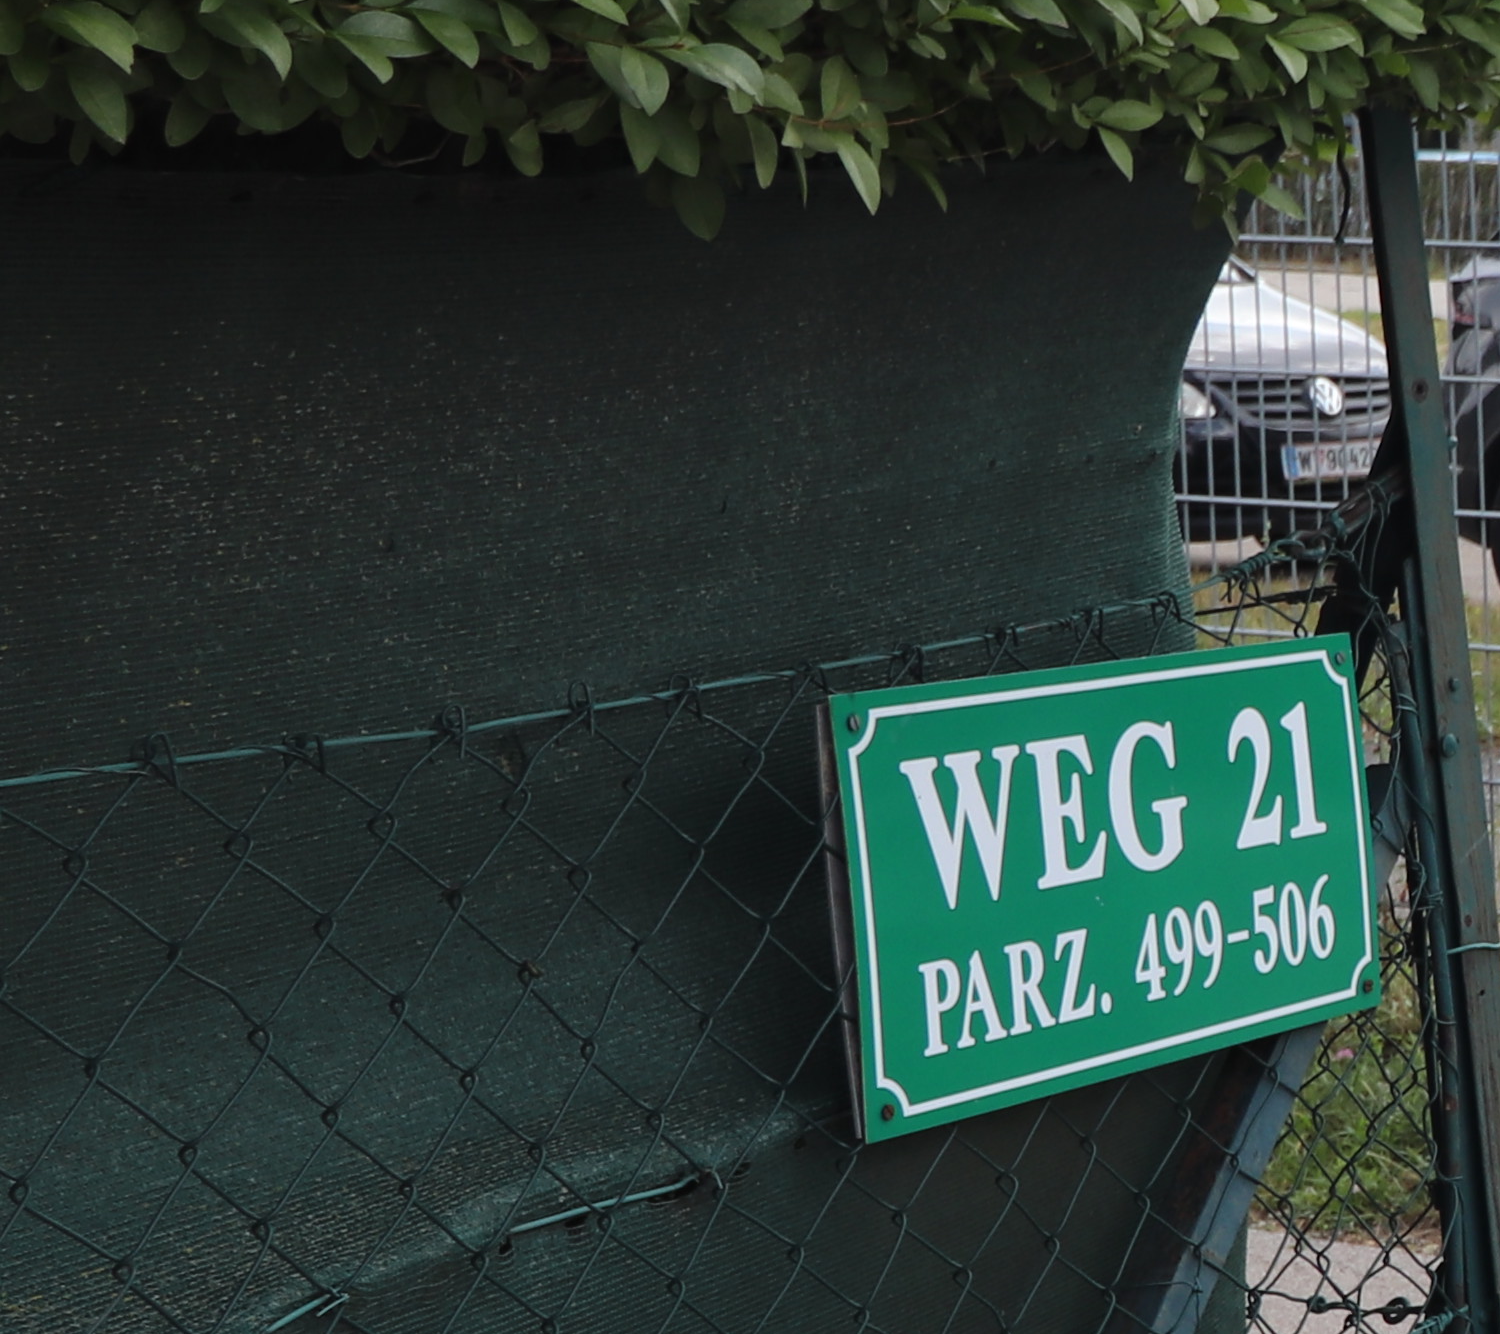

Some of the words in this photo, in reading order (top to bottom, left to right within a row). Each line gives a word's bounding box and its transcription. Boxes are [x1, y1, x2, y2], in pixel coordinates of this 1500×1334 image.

[899, 720, 1189, 911] WEG
[1227, 700, 1328, 851] 21
[917, 927, 1113, 1058] PARZ.
[1135, 873, 1336, 1002] 499-506
